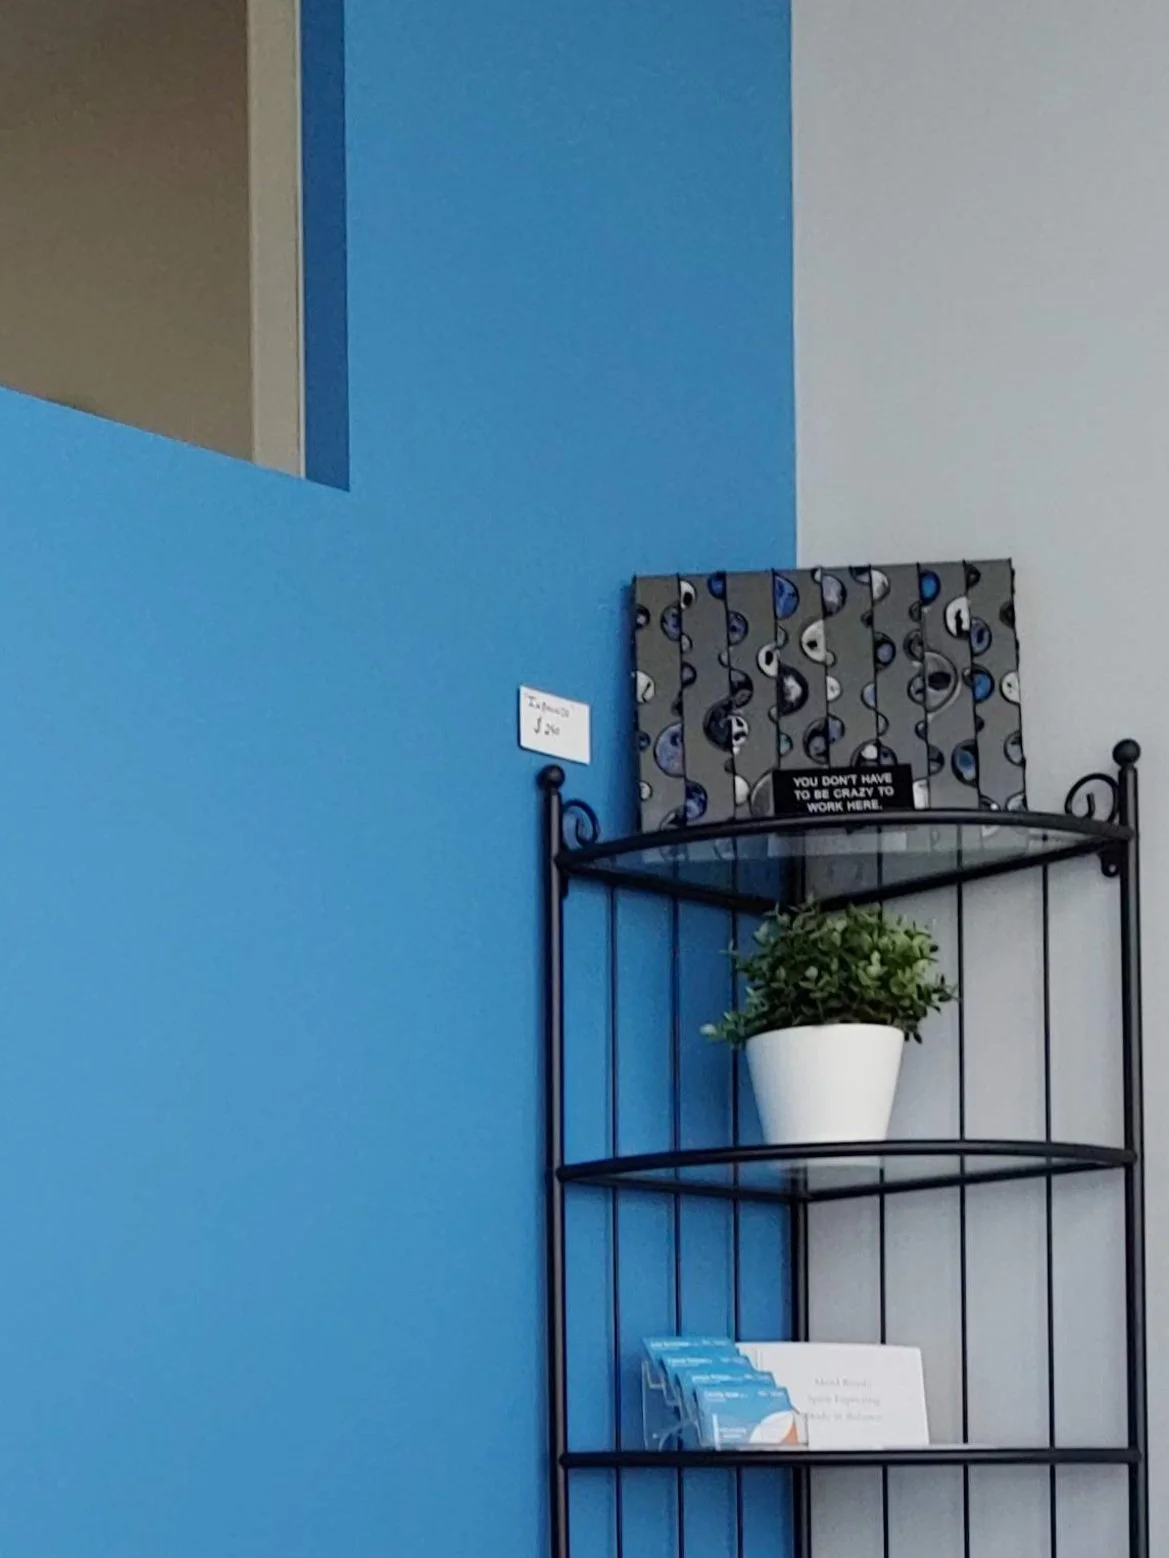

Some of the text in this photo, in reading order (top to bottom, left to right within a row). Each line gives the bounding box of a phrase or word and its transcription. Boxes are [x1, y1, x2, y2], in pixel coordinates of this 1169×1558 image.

[793, 772, 893, 788] YOU DON'T HAVE
[794, 786, 895, 800] TO BE CRAZY TO
[806, 799, 883, 813] WORK HERE.
